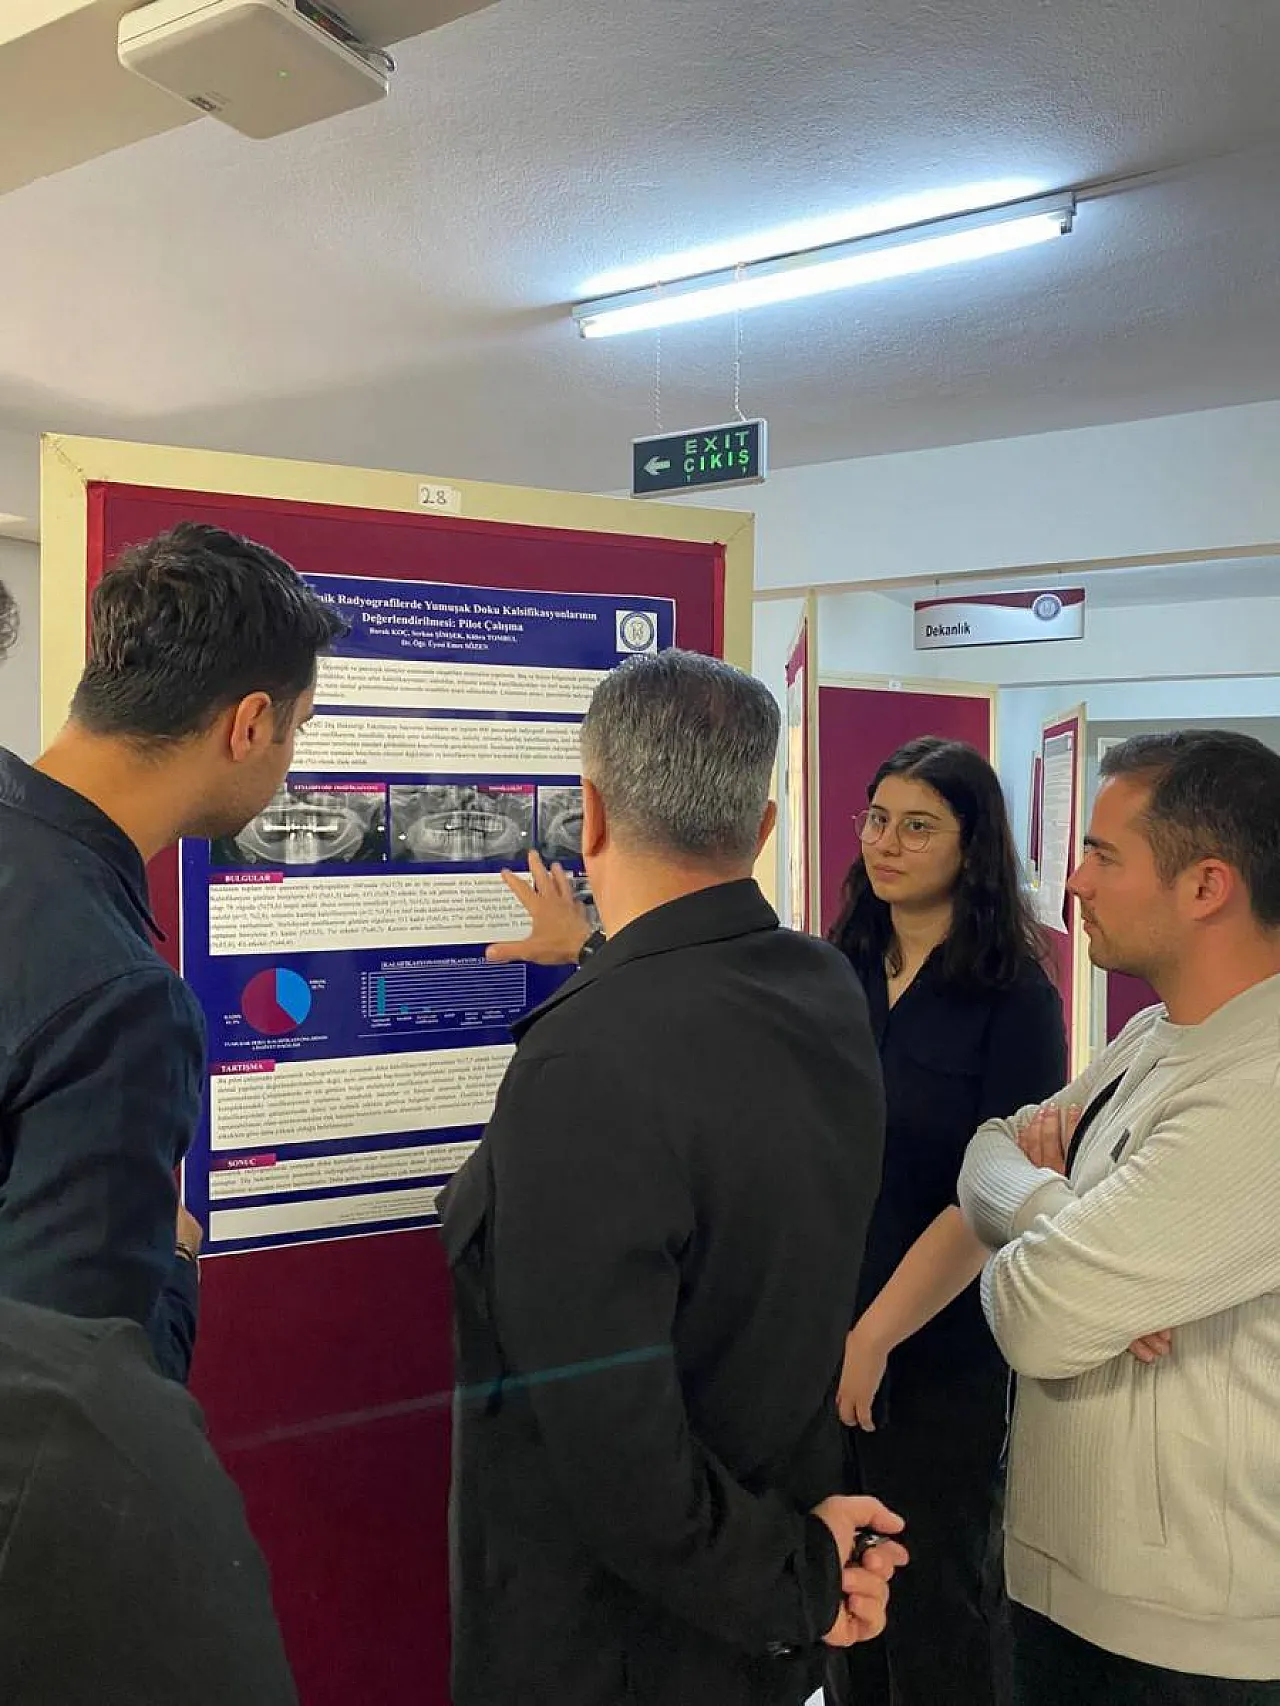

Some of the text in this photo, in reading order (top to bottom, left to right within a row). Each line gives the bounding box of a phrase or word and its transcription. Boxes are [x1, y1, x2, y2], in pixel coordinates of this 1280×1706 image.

[684, 431, 750, 456] EXIT
[683, 449, 750, 482] ÇIKIŞ
[420, 487, 447, 505] 28
[337, 593, 423, 610] Radyografilerde
[424, 600, 471, 616] Yumuşak
[473, 603, 500, 615] Doku
[503, 605, 597, 621] Kalsifikasyonlarının
[362, 612, 524, 633] Değerlendirilmesi: Pilot Çalışma
[925, 622, 971, 638] Dekanlık
[225, 874, 271, 883] BULGULAR
[221, 1064, 264, 1073] TARTIŞMA
